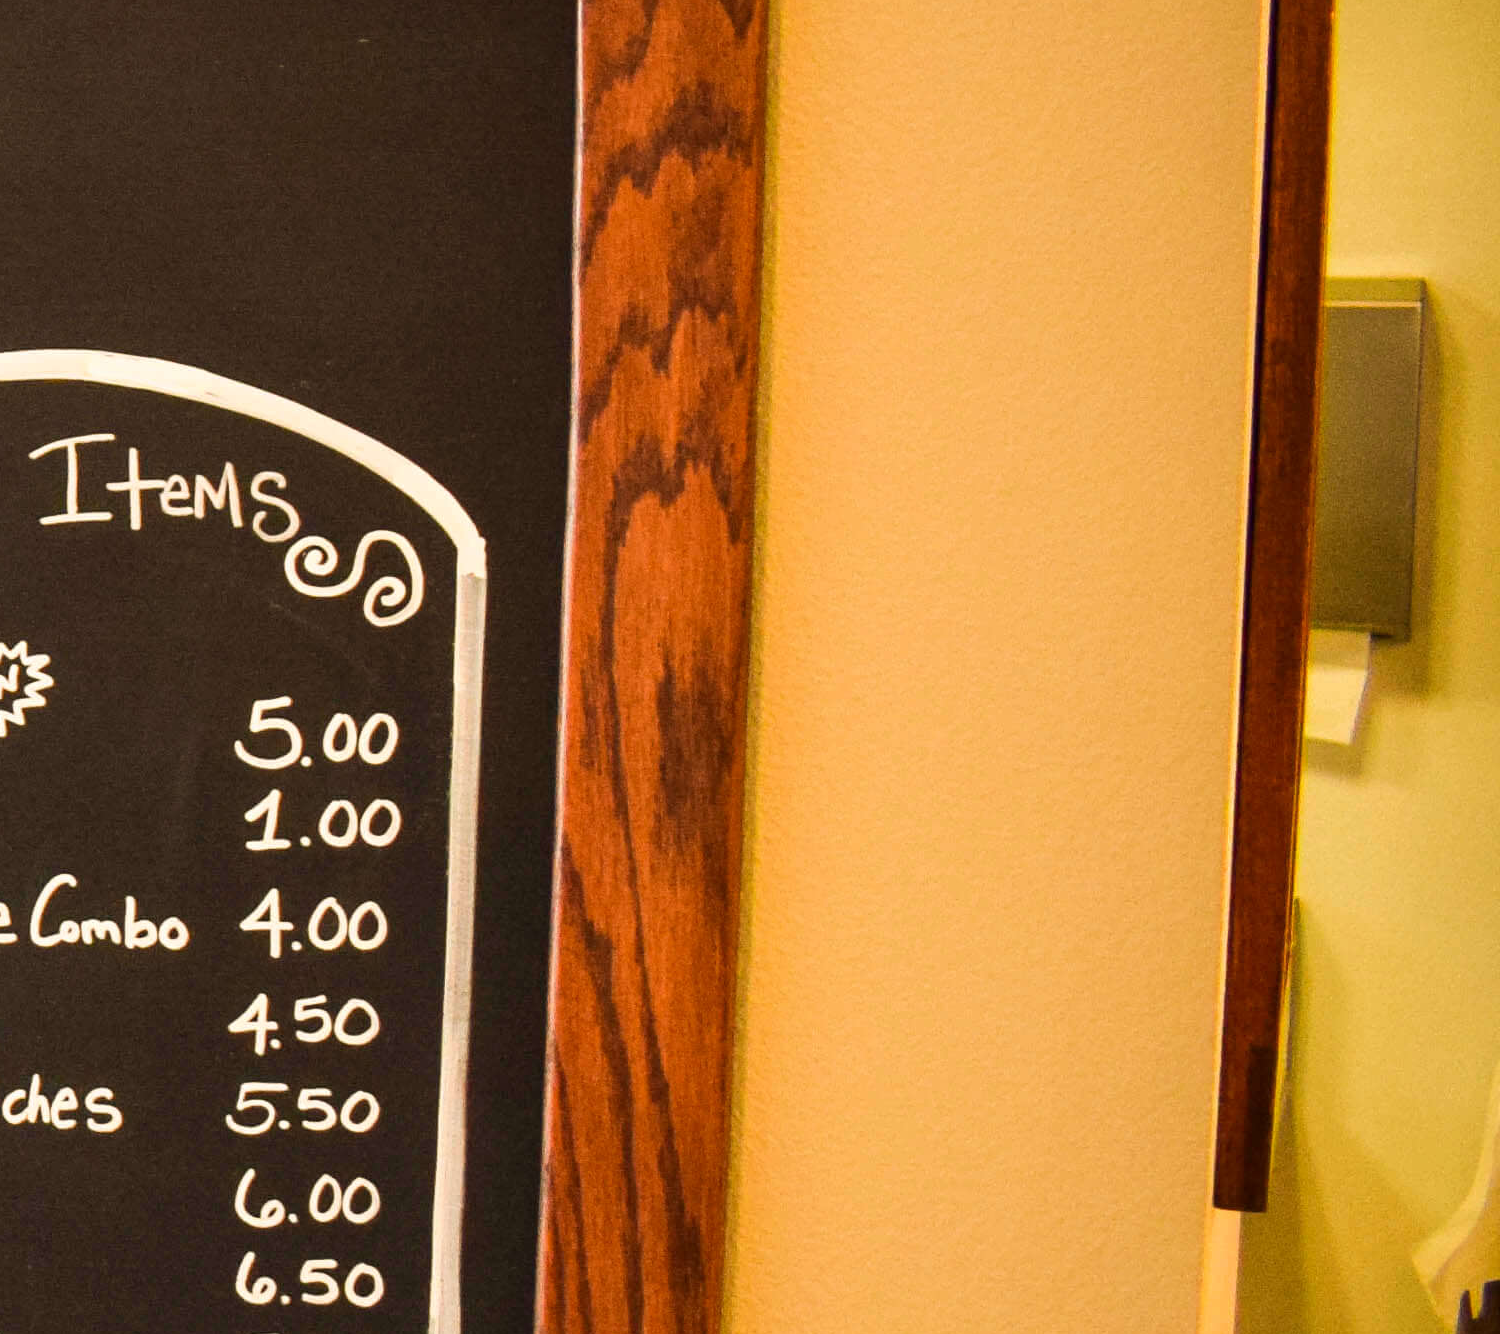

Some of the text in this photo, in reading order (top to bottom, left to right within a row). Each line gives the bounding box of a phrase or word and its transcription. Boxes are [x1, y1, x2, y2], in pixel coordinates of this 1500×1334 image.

[235, 696, 398, 769] 5.00
[245, 789, 401, 850] 1.00
[30, 874, 189, 950] Combo
[240, 889, 387, 958] 4.00
[228, 994, 379, 1055] 4.50
[226, 1082, 379, 1134] 5.50
[235, 1169, 380, 1228] 6.00
[236, 1252, 384, 1307] 6.50
